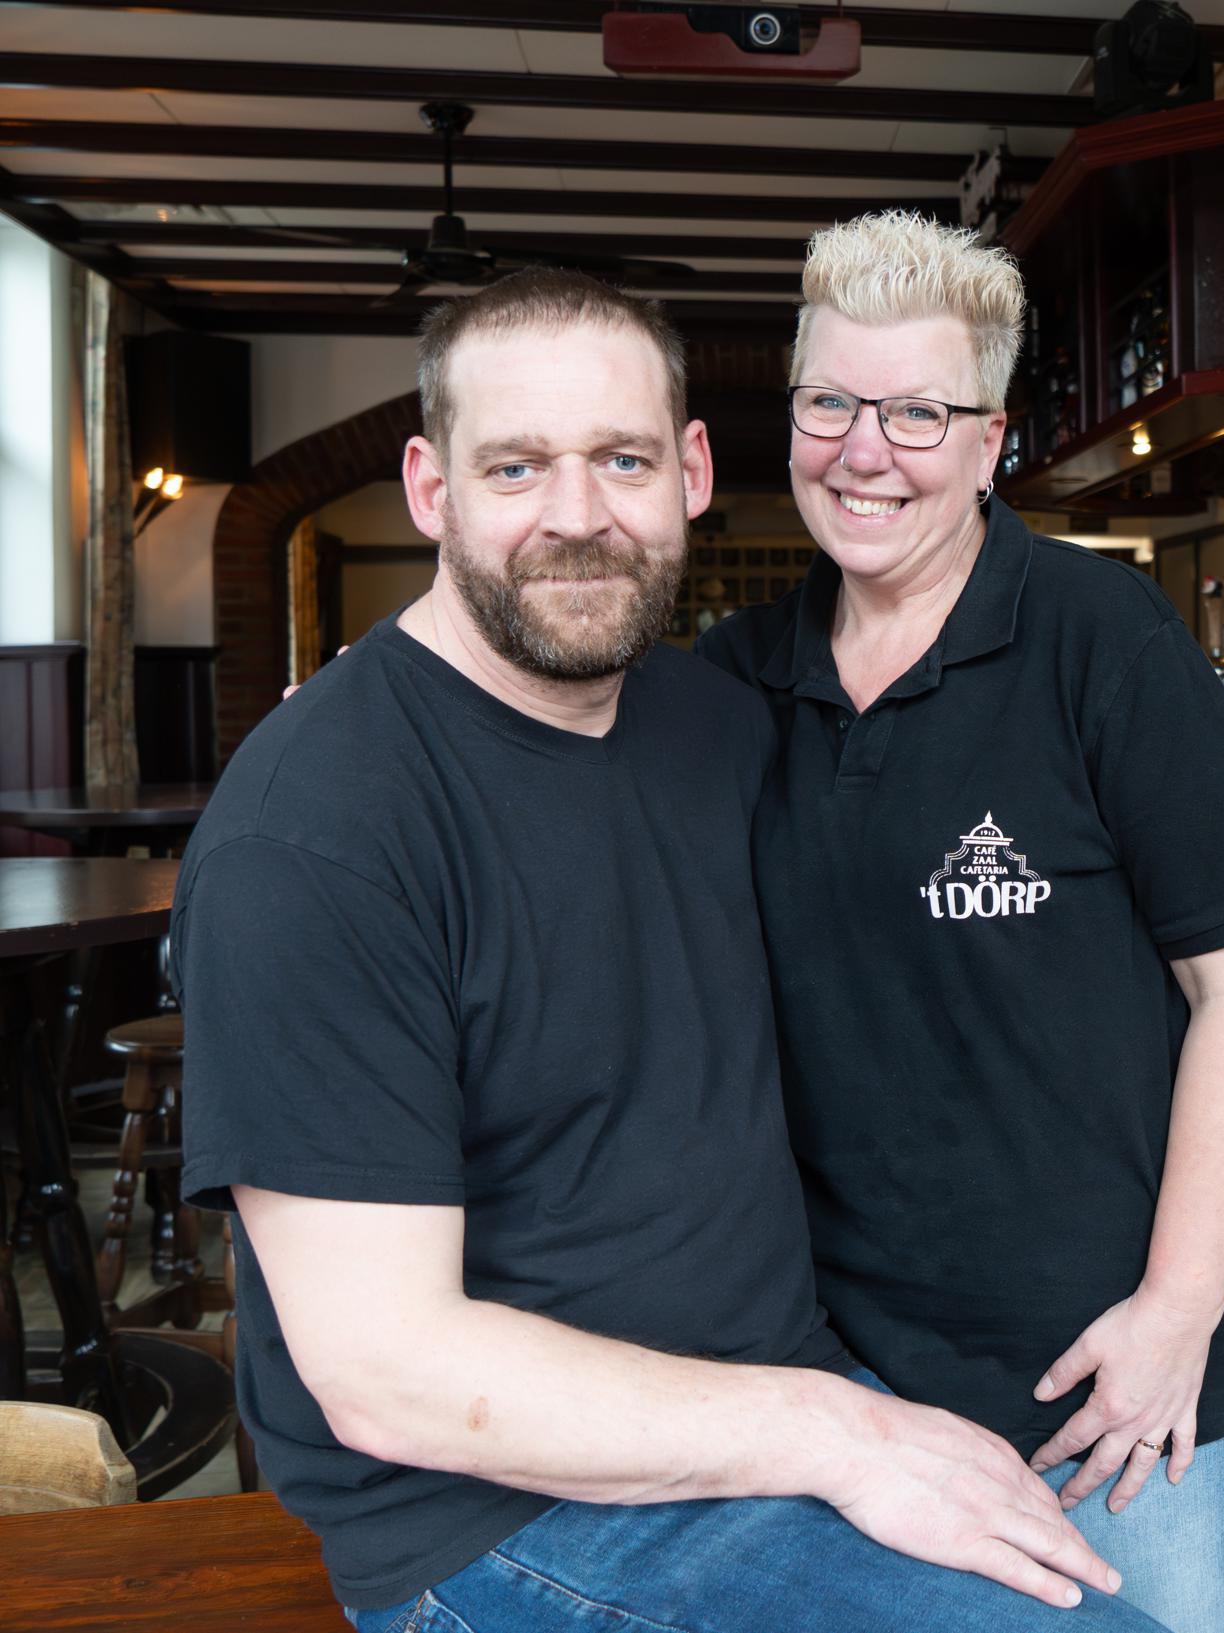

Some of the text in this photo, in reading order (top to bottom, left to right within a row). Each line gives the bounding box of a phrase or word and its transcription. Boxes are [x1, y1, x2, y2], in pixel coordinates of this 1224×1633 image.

[974, 845, 998, 855] CAFÉ
[972, 856, 998, 865] ZAAL
[960, 866, 1009, 875] CAFETARIA
[919, 875, 1051, 919] 't DÖRP
